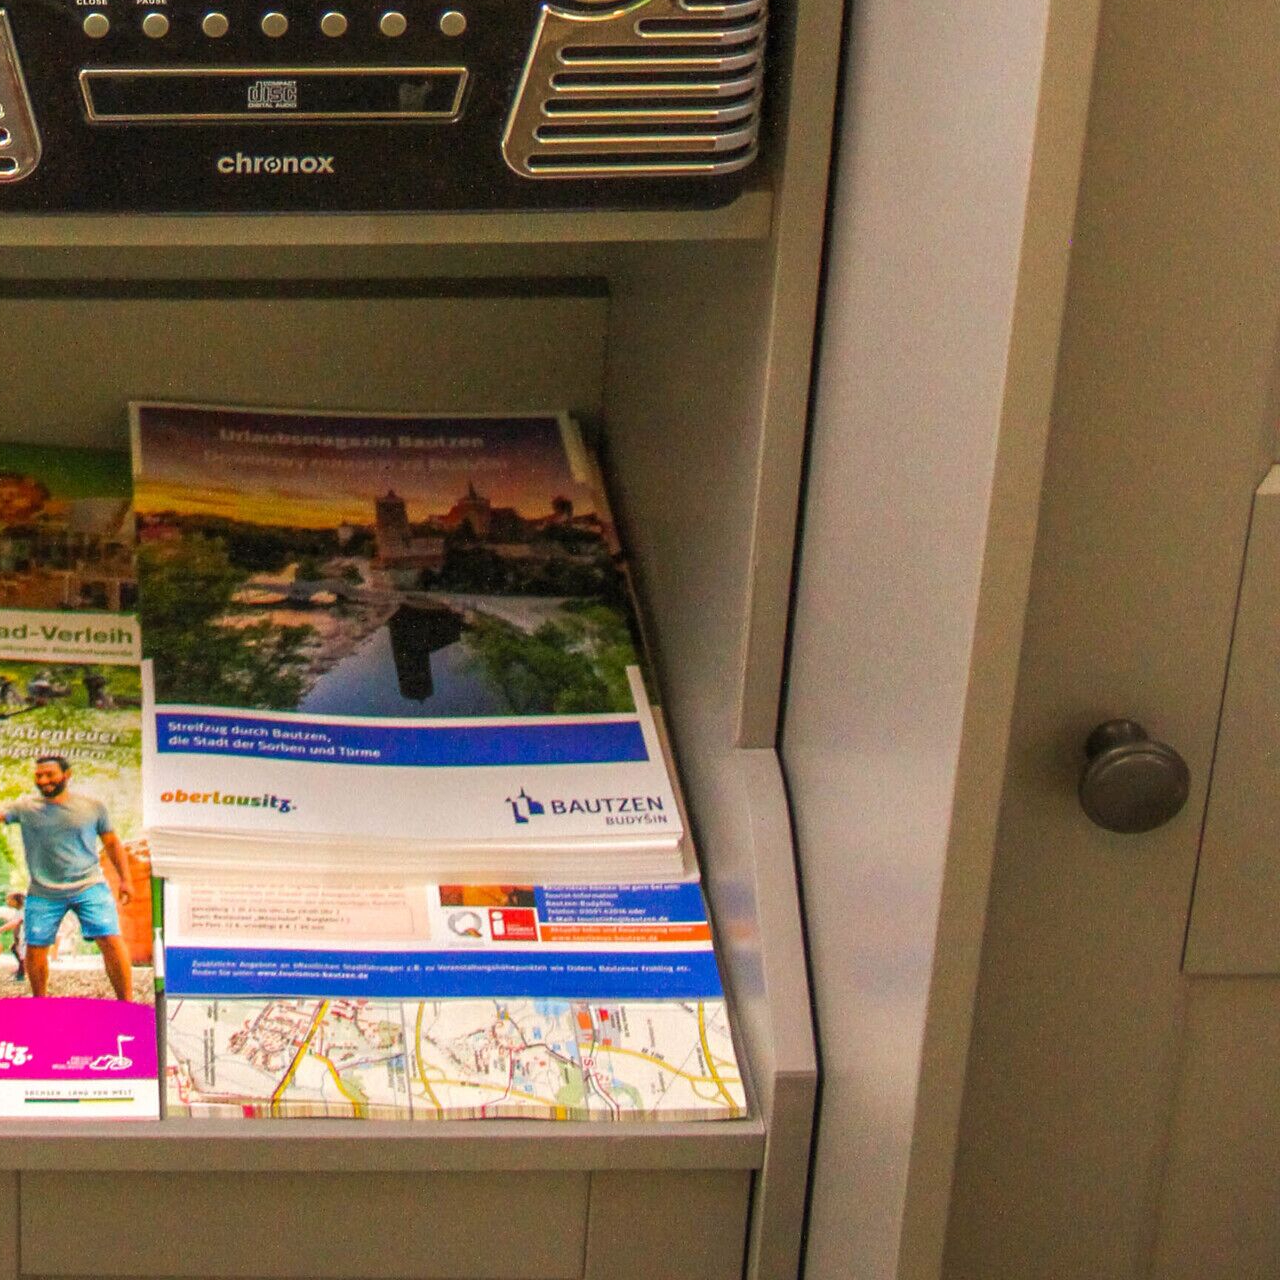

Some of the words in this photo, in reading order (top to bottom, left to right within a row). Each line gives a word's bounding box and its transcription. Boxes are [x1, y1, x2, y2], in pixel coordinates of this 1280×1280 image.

[217, 152, 335, 174] chronox
[12, 726, 119, 743] Abenteuer
[168, 721, 228, 735] Streifzug
[231, 725, 268, 737] durch
[272, 728, 332, 743] Bautzen,
[168, 736, 189, 746] die
[193, 736, 229, 748] Stadt
[233, 739, 254, 749] der
[258, 741, 306, 754] Sorben
[310, 745, 335, 755] und
[340, 746, 381, 758] Türme
[551, 796, 665, 815] BAUTZEN
[606, 813, 668, 825] BUDYŠIN
